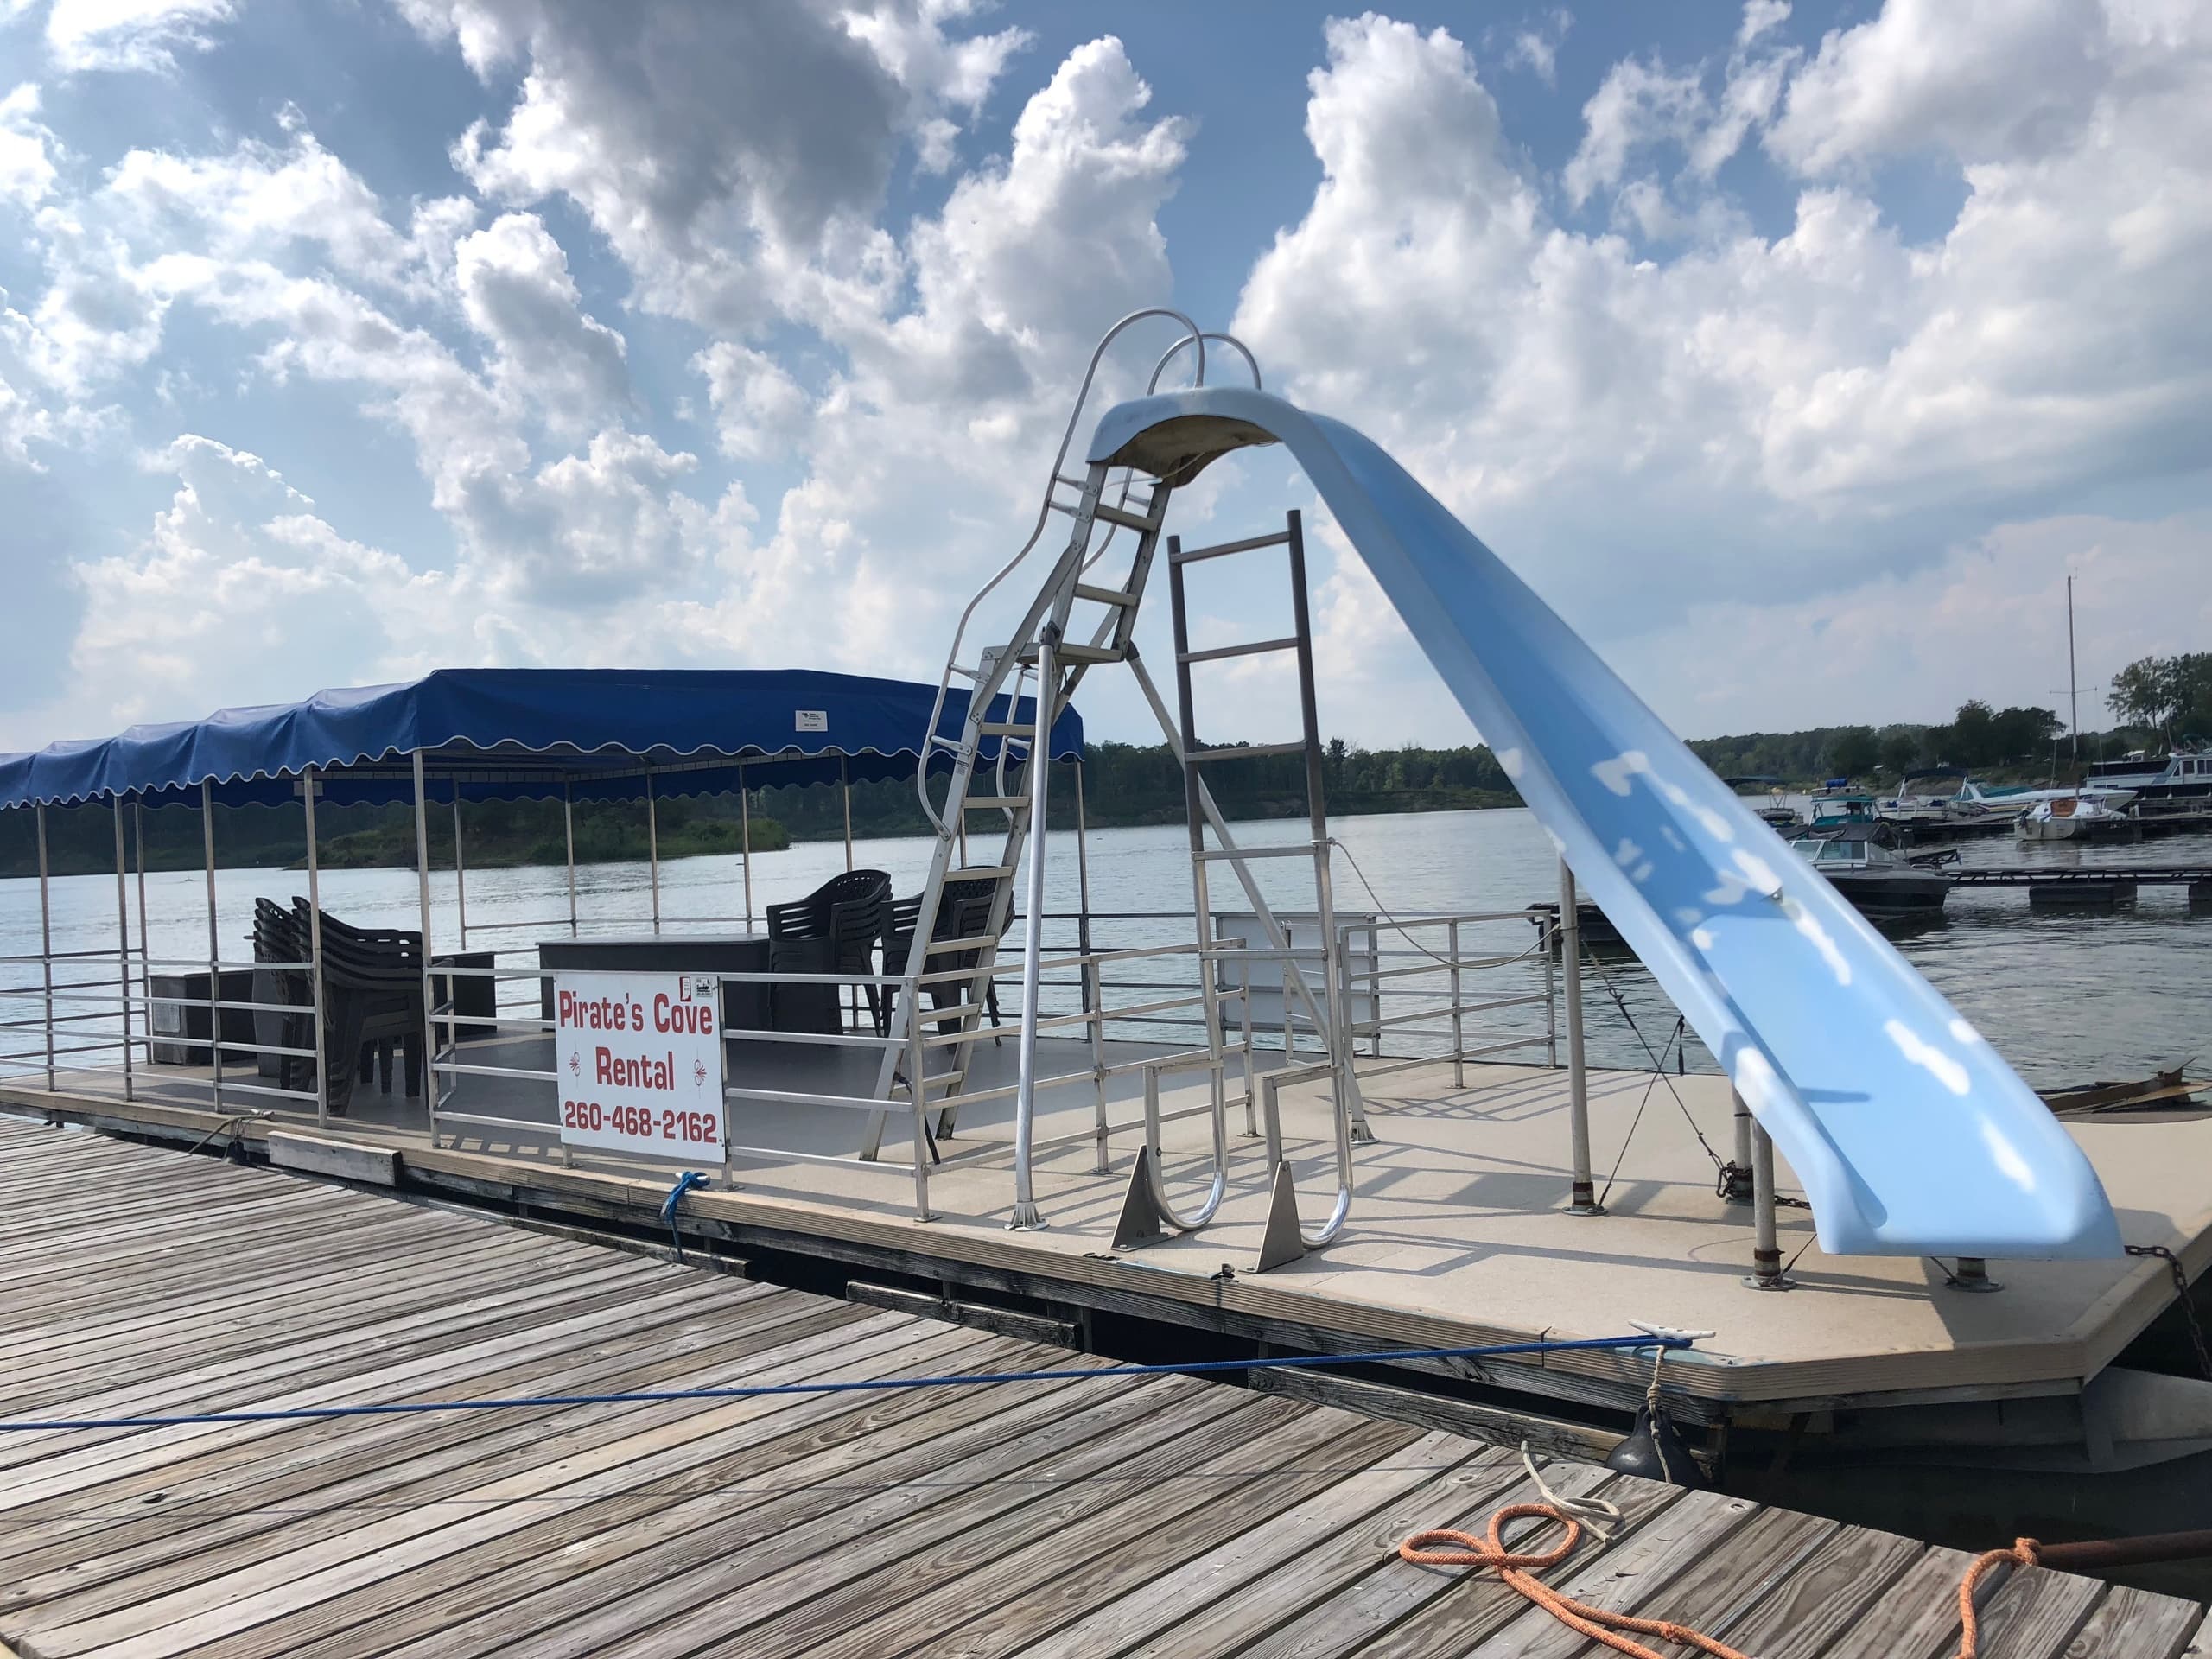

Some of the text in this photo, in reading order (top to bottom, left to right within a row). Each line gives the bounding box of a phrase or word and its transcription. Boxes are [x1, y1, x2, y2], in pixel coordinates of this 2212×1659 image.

[559, 990, 713, 1034] Pirate's Cove
[595, 1046, 675, 1090] Rental
[564, 1101, 717, 1144] 260-468-2162
